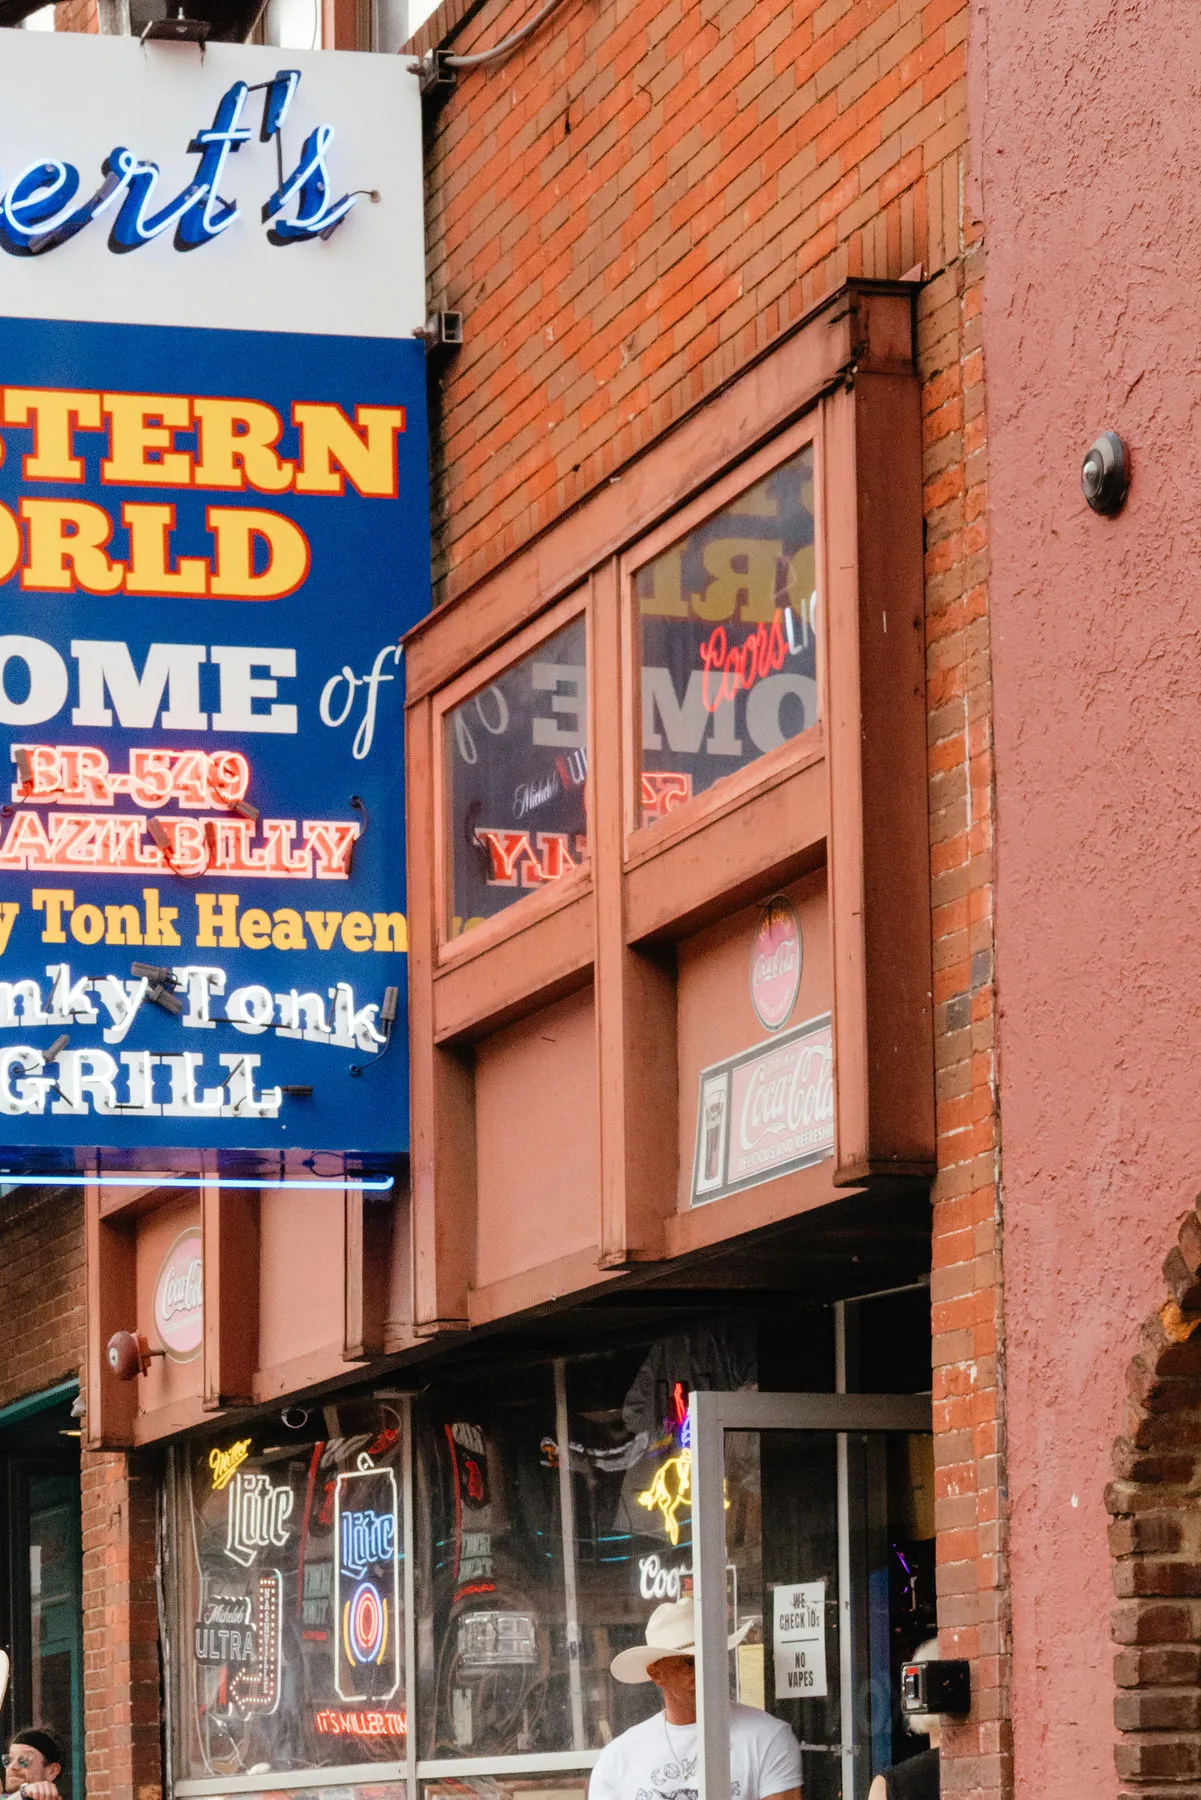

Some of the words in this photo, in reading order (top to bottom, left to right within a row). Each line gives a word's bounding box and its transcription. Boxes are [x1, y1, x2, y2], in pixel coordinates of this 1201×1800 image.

[700, 606, 789, 713] Coors
[319, 644, 403, 761] of
[10, 743, 251, 811] BR-549
[31, 887, 182, 947] Tonk
[195, 893, 408, 953] Heaven
[172, 965, 389, 1053] Tonk
[209, 1438, 252, 1487] Miller
[223, 1472, 294, 1568] Lite
[341, 1510, 396, 1581] Lite
[204, 1601, 246, 1625] Michelob
[779, 1612, 805, 1631] CHECK
[792, 1592, 805, 1609] WE
[195, 1628, 257, 1662] ULTRA
[794, 1652, 806, 1669] NO
[787, 1670, 814, 1689] VAPES
[315, 1709, 339, 1734] IT'S
[340, 1711, 386, 1735] MILLER
